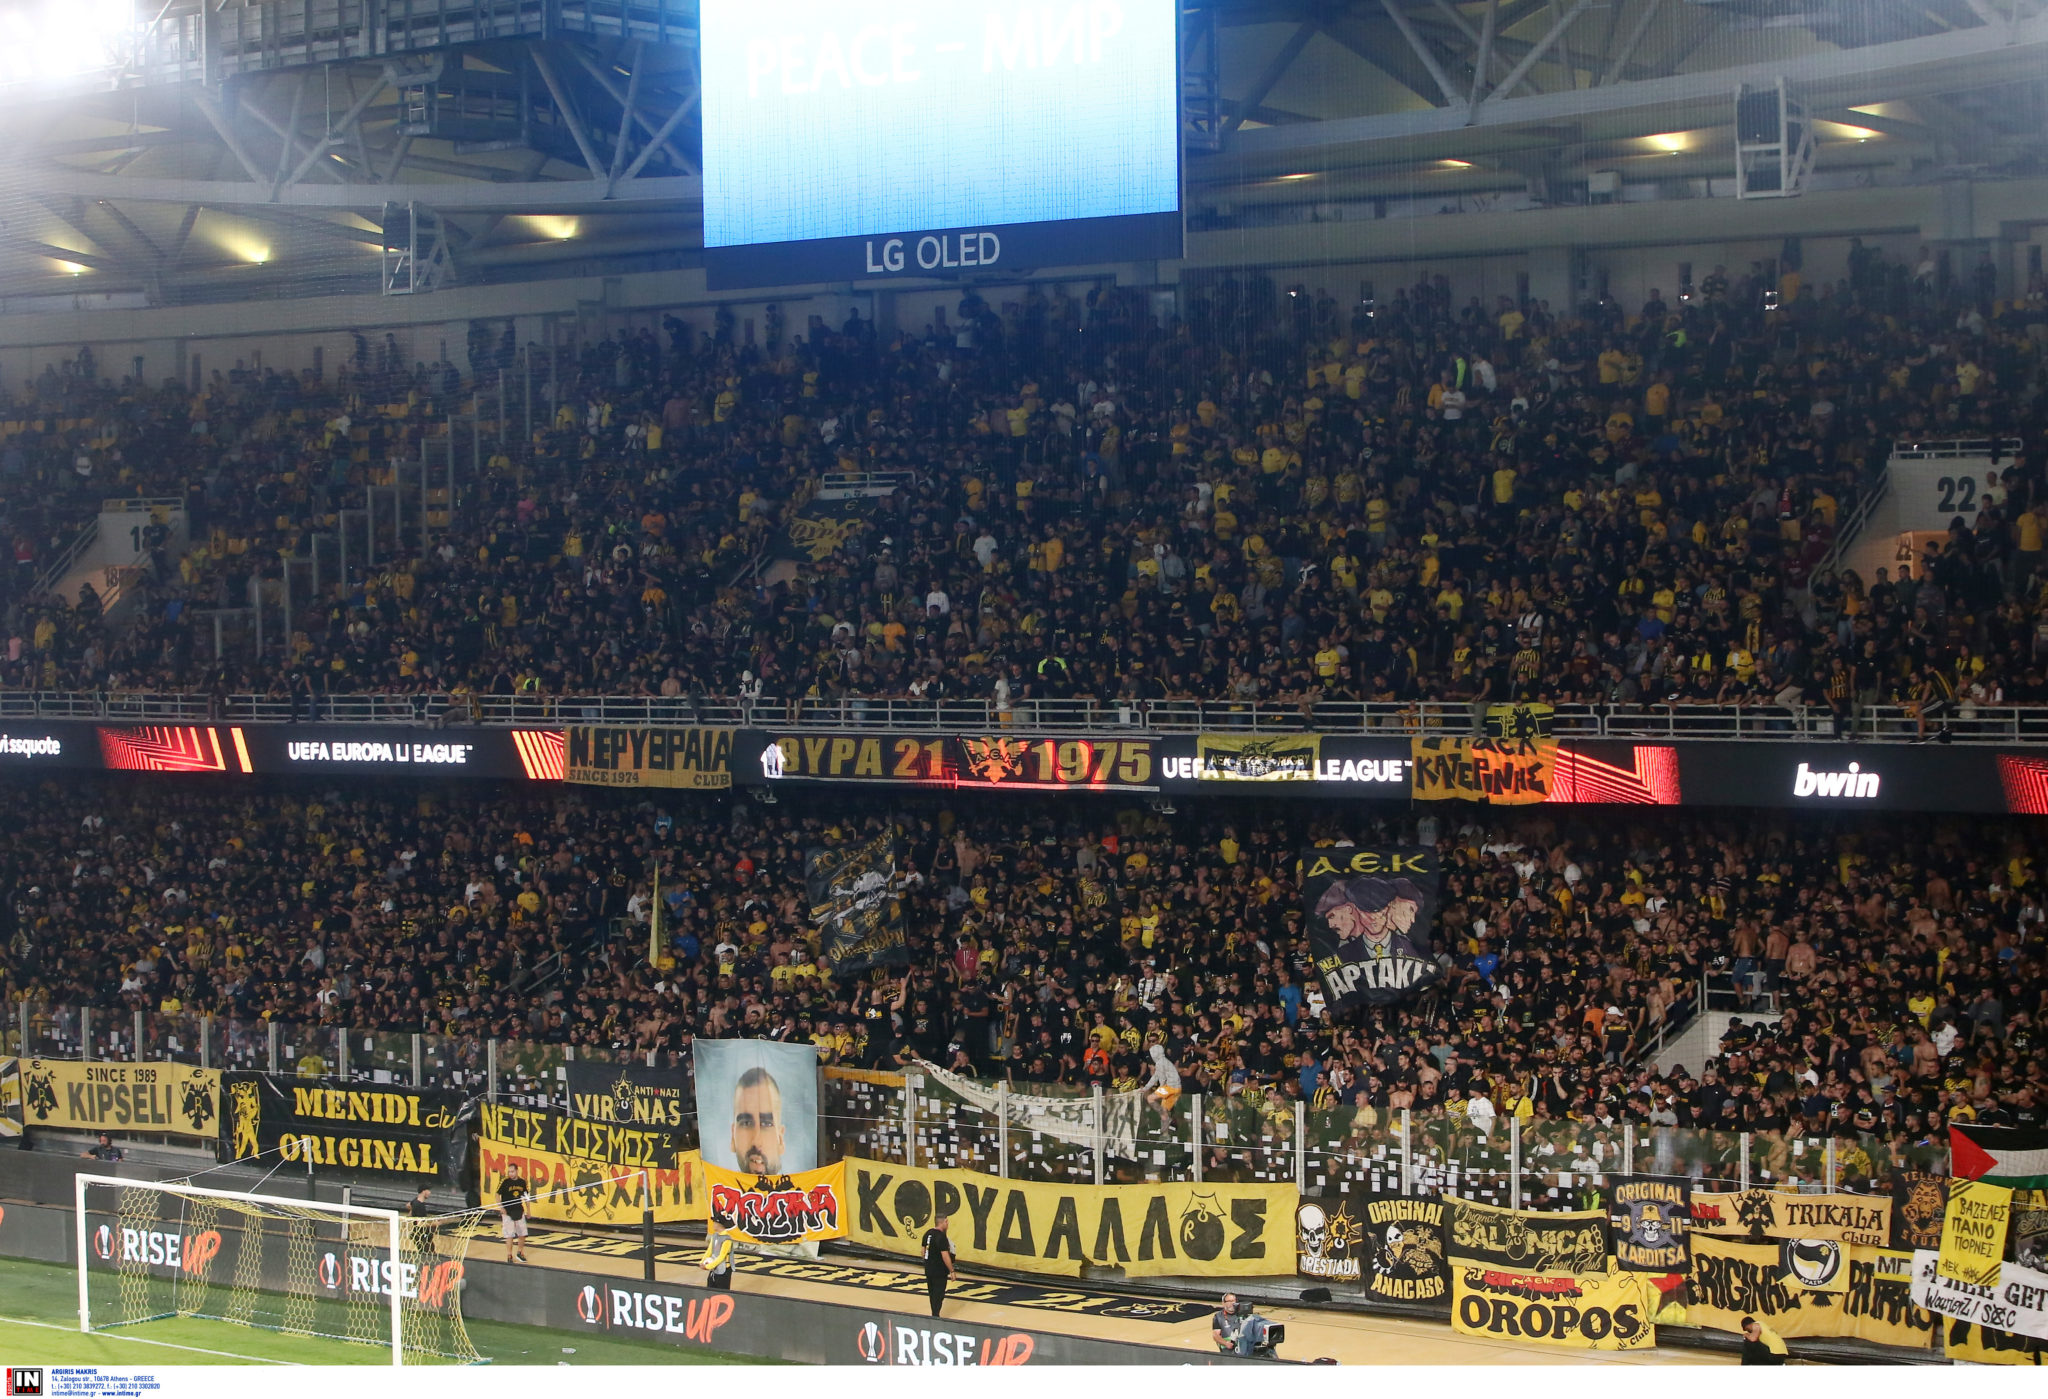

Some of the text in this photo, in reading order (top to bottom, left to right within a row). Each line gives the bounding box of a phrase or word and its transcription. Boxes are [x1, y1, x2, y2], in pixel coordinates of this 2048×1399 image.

[745, 20, 920, 98] PEACE
[866, 232, 1000, 273] LG OLED
[1938, 476, 1976, 513] 22
[288, 742, 330, 760] UEFA
[332, 743, 393, 761] EUROPA
[893, 738, 944, 776] 21
[1031, 740, 1151, 782] 1975
[569, 769, 640, 783] SINCE 1974
[693, 773, 730, 786] CLUB
[1793, 761, 1881, 798] bwin
[86, 1068, 157, 1082] SINCE 1989
[634, 1085, 680, 1098] ANTI NAZI
[67, 1082, 172, 1124] KIPSELI
[292, 1087, 420, 1126] MENIDI
[278, 1132, 438, 1175] ORIGINAL
[480, 1102, 660, 1168] ΝΕΟΣ ΚΟΣΜΟΣ
[1616, 1182, 1684, 1206] ORIGINAL
[1367, 1199, 1444, 1227] ORIGINAL
[1785, 1203, 1884, 1231] TRIKALA
[121, 1228, 222, 1276] RISE UP
[1617, 1241, 1687, 1268] KARDITSA
[1841, 1231, 1881, 1246] CLUB
[1955, 1235, 1995, 1258] ΠΟΡΝΕΣ
[349, 1255, 465, 1308] RISE UP
[1570, 1252, 1605, 1275] Club
[611, 1289, 735, 1344] RISE UP
[1460, 1294, 1640, 1340] OROPOS
[895, 1325, 1035, 1366] RISE UP
[1629, 1326, 1651, 1346] Club
